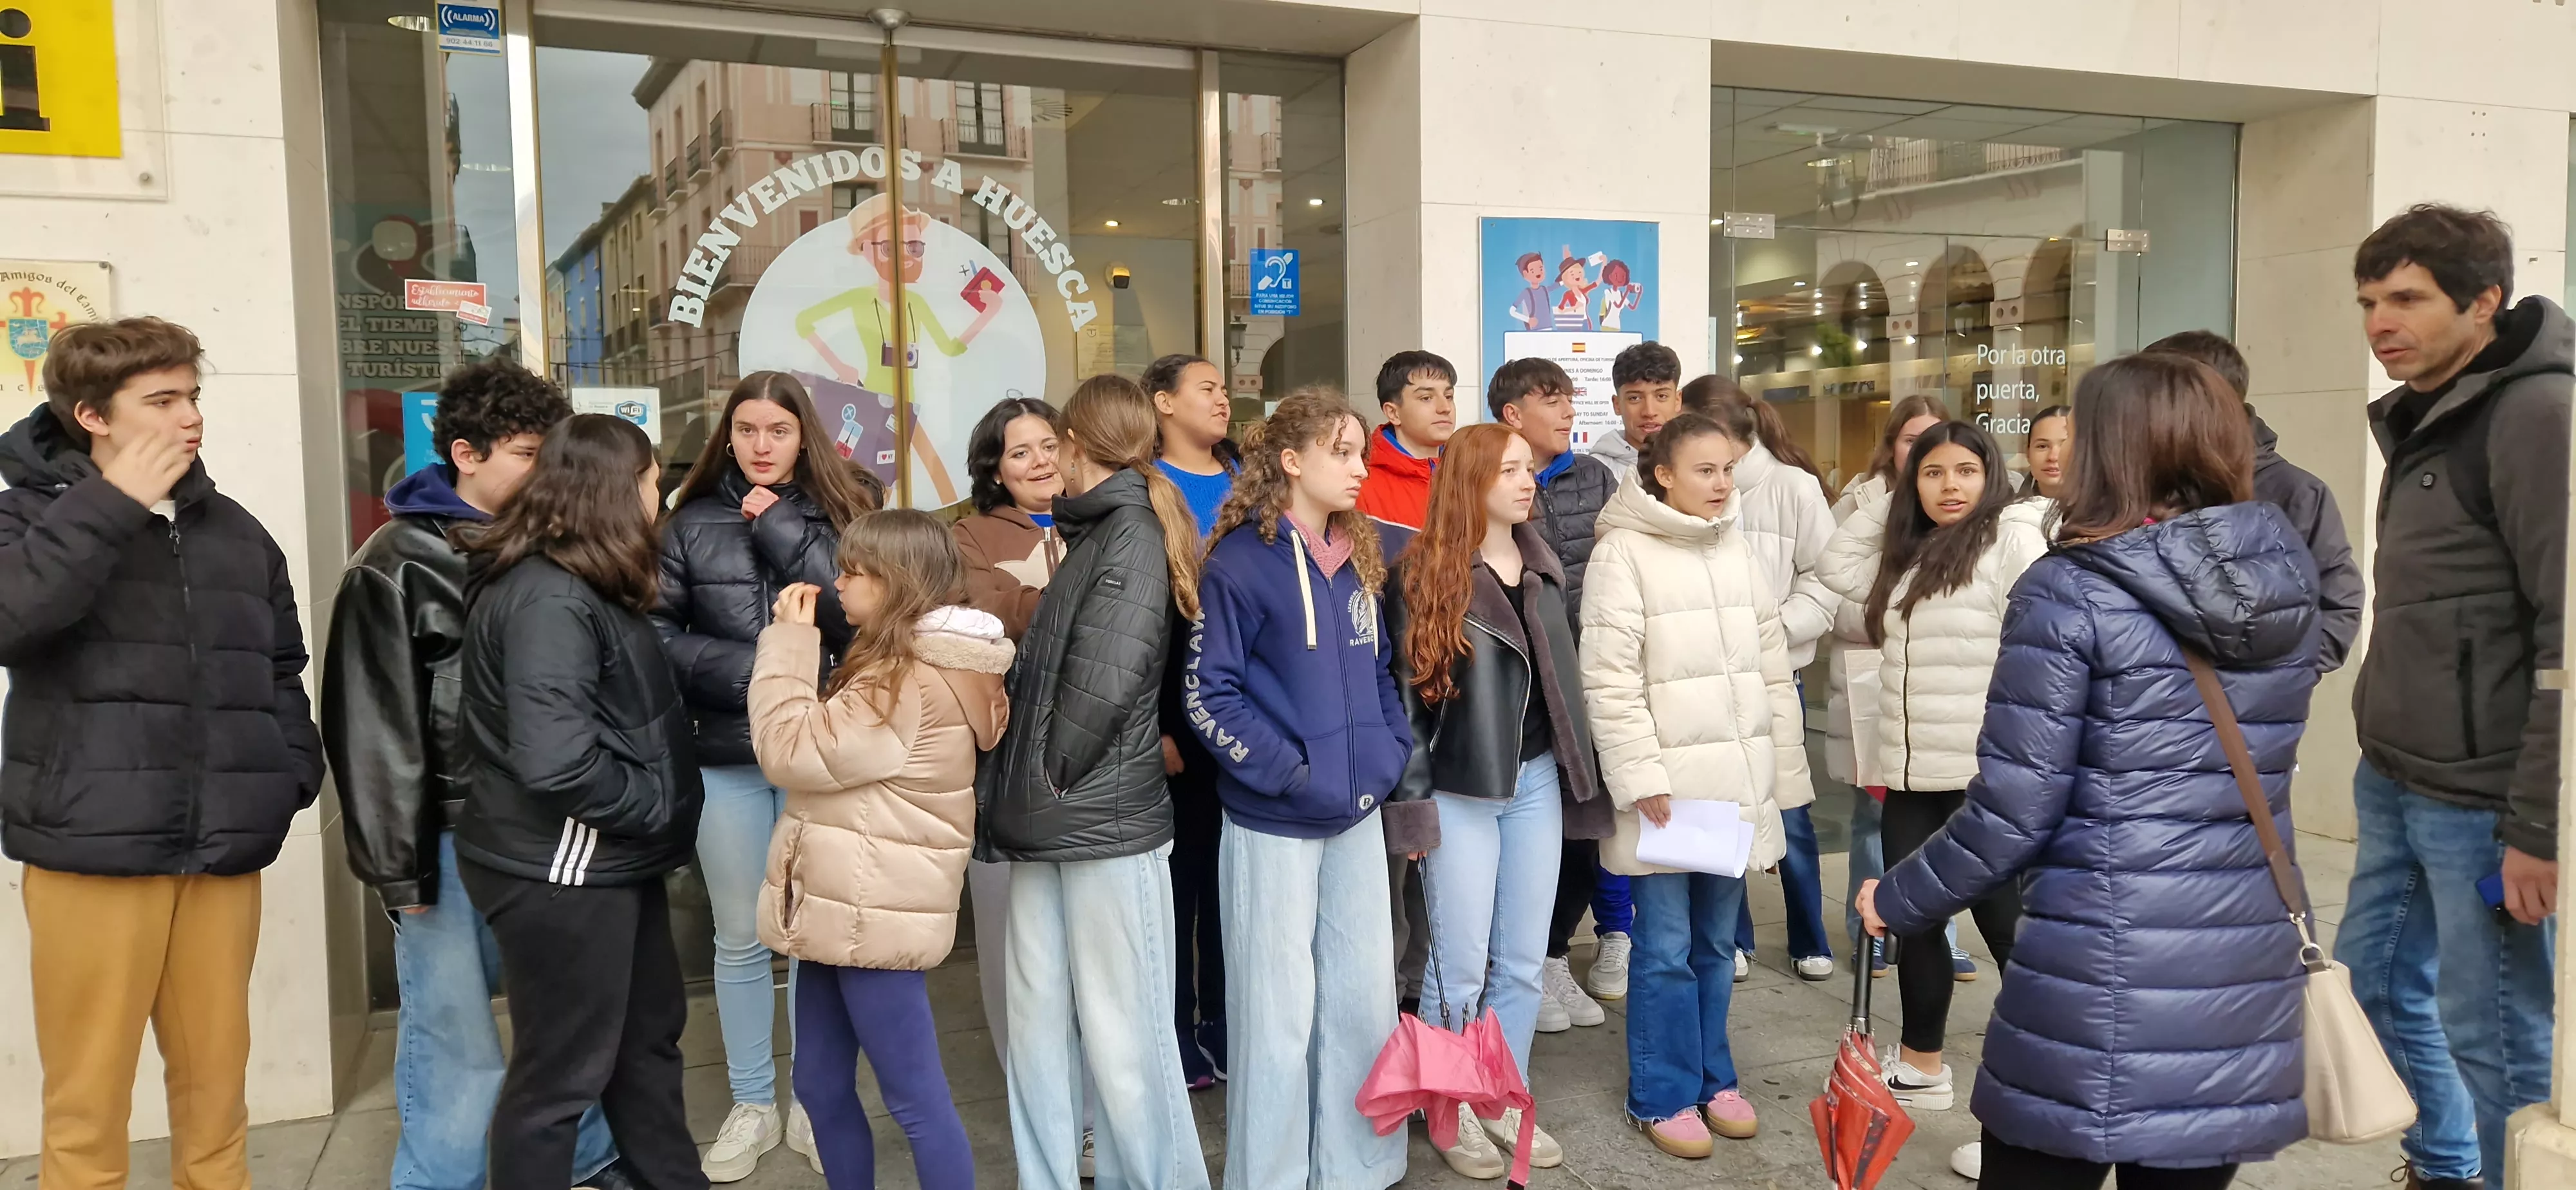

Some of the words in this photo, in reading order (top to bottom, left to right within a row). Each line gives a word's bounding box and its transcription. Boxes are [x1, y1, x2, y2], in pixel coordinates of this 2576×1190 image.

[453, 13, 485, 23] ALARMA
[668, 147, 922, 328] BIENVENIDOS
[931, 158, 964, 194] A
[971, 175, 1097, 332] HUESCA
[1283, 279, 1290, 288] T
[0, 271, 52, 283] Amigos
[57, 280, 77, 296] del
[76, 294, 99, 321] Cami
[366, 317, 455, 332] TIEMPO
[1978, 344, 2007, 365] Por
[2012, 343, 2025, 365] la
[2031, 346, 2065, 365] otra
[1976, 380, 2040, 405] puerta,
[1976, 413, 2031, 434] Gracia
[1349, 635, 1374, 647] RAVENC
